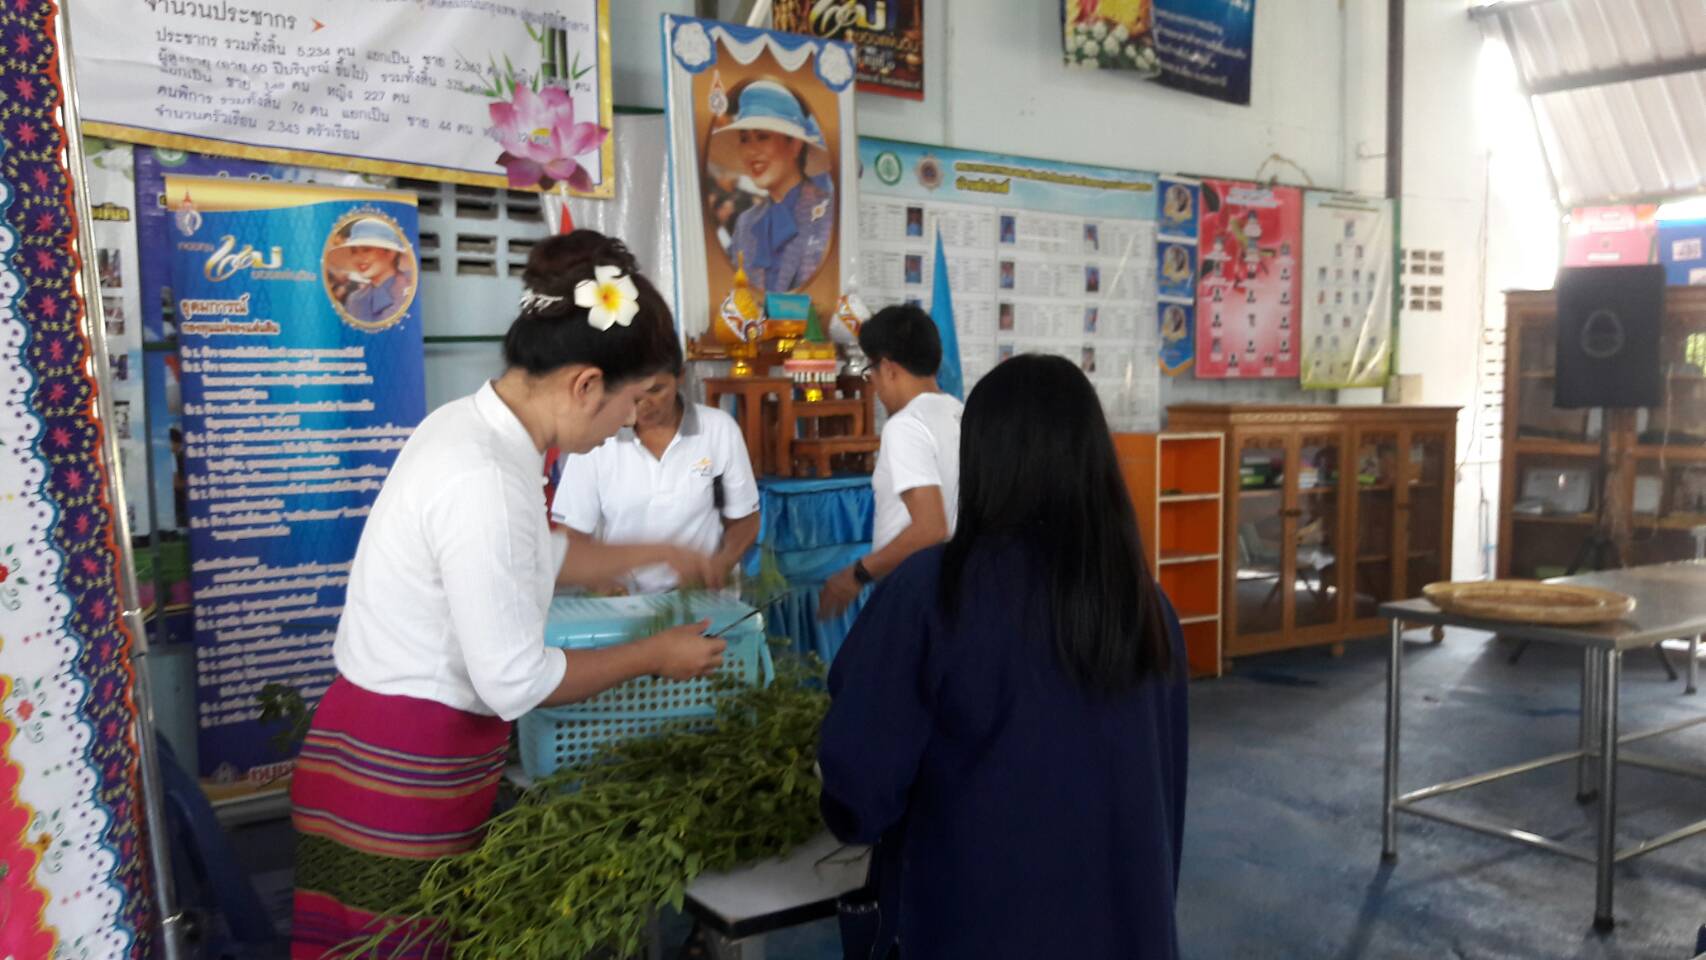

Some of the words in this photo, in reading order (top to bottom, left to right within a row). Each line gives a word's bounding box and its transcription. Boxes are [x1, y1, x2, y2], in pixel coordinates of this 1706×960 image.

[156, 27, 218, 47] ประชากร
[225, 32, 286, 55] รวมทั้งสิ้น
[337, 47, 355, 57] คน
[157, 84, 213, 104] คนพิการ
[310, 106, 329, 117] คน
[292, 81, 309, 92] คน
[392, 93, 410, 104] คน
[155, 104, 257, 128] จำนวนครัวเรือน
[307, 123, 360, 140] ครัวเรือน
